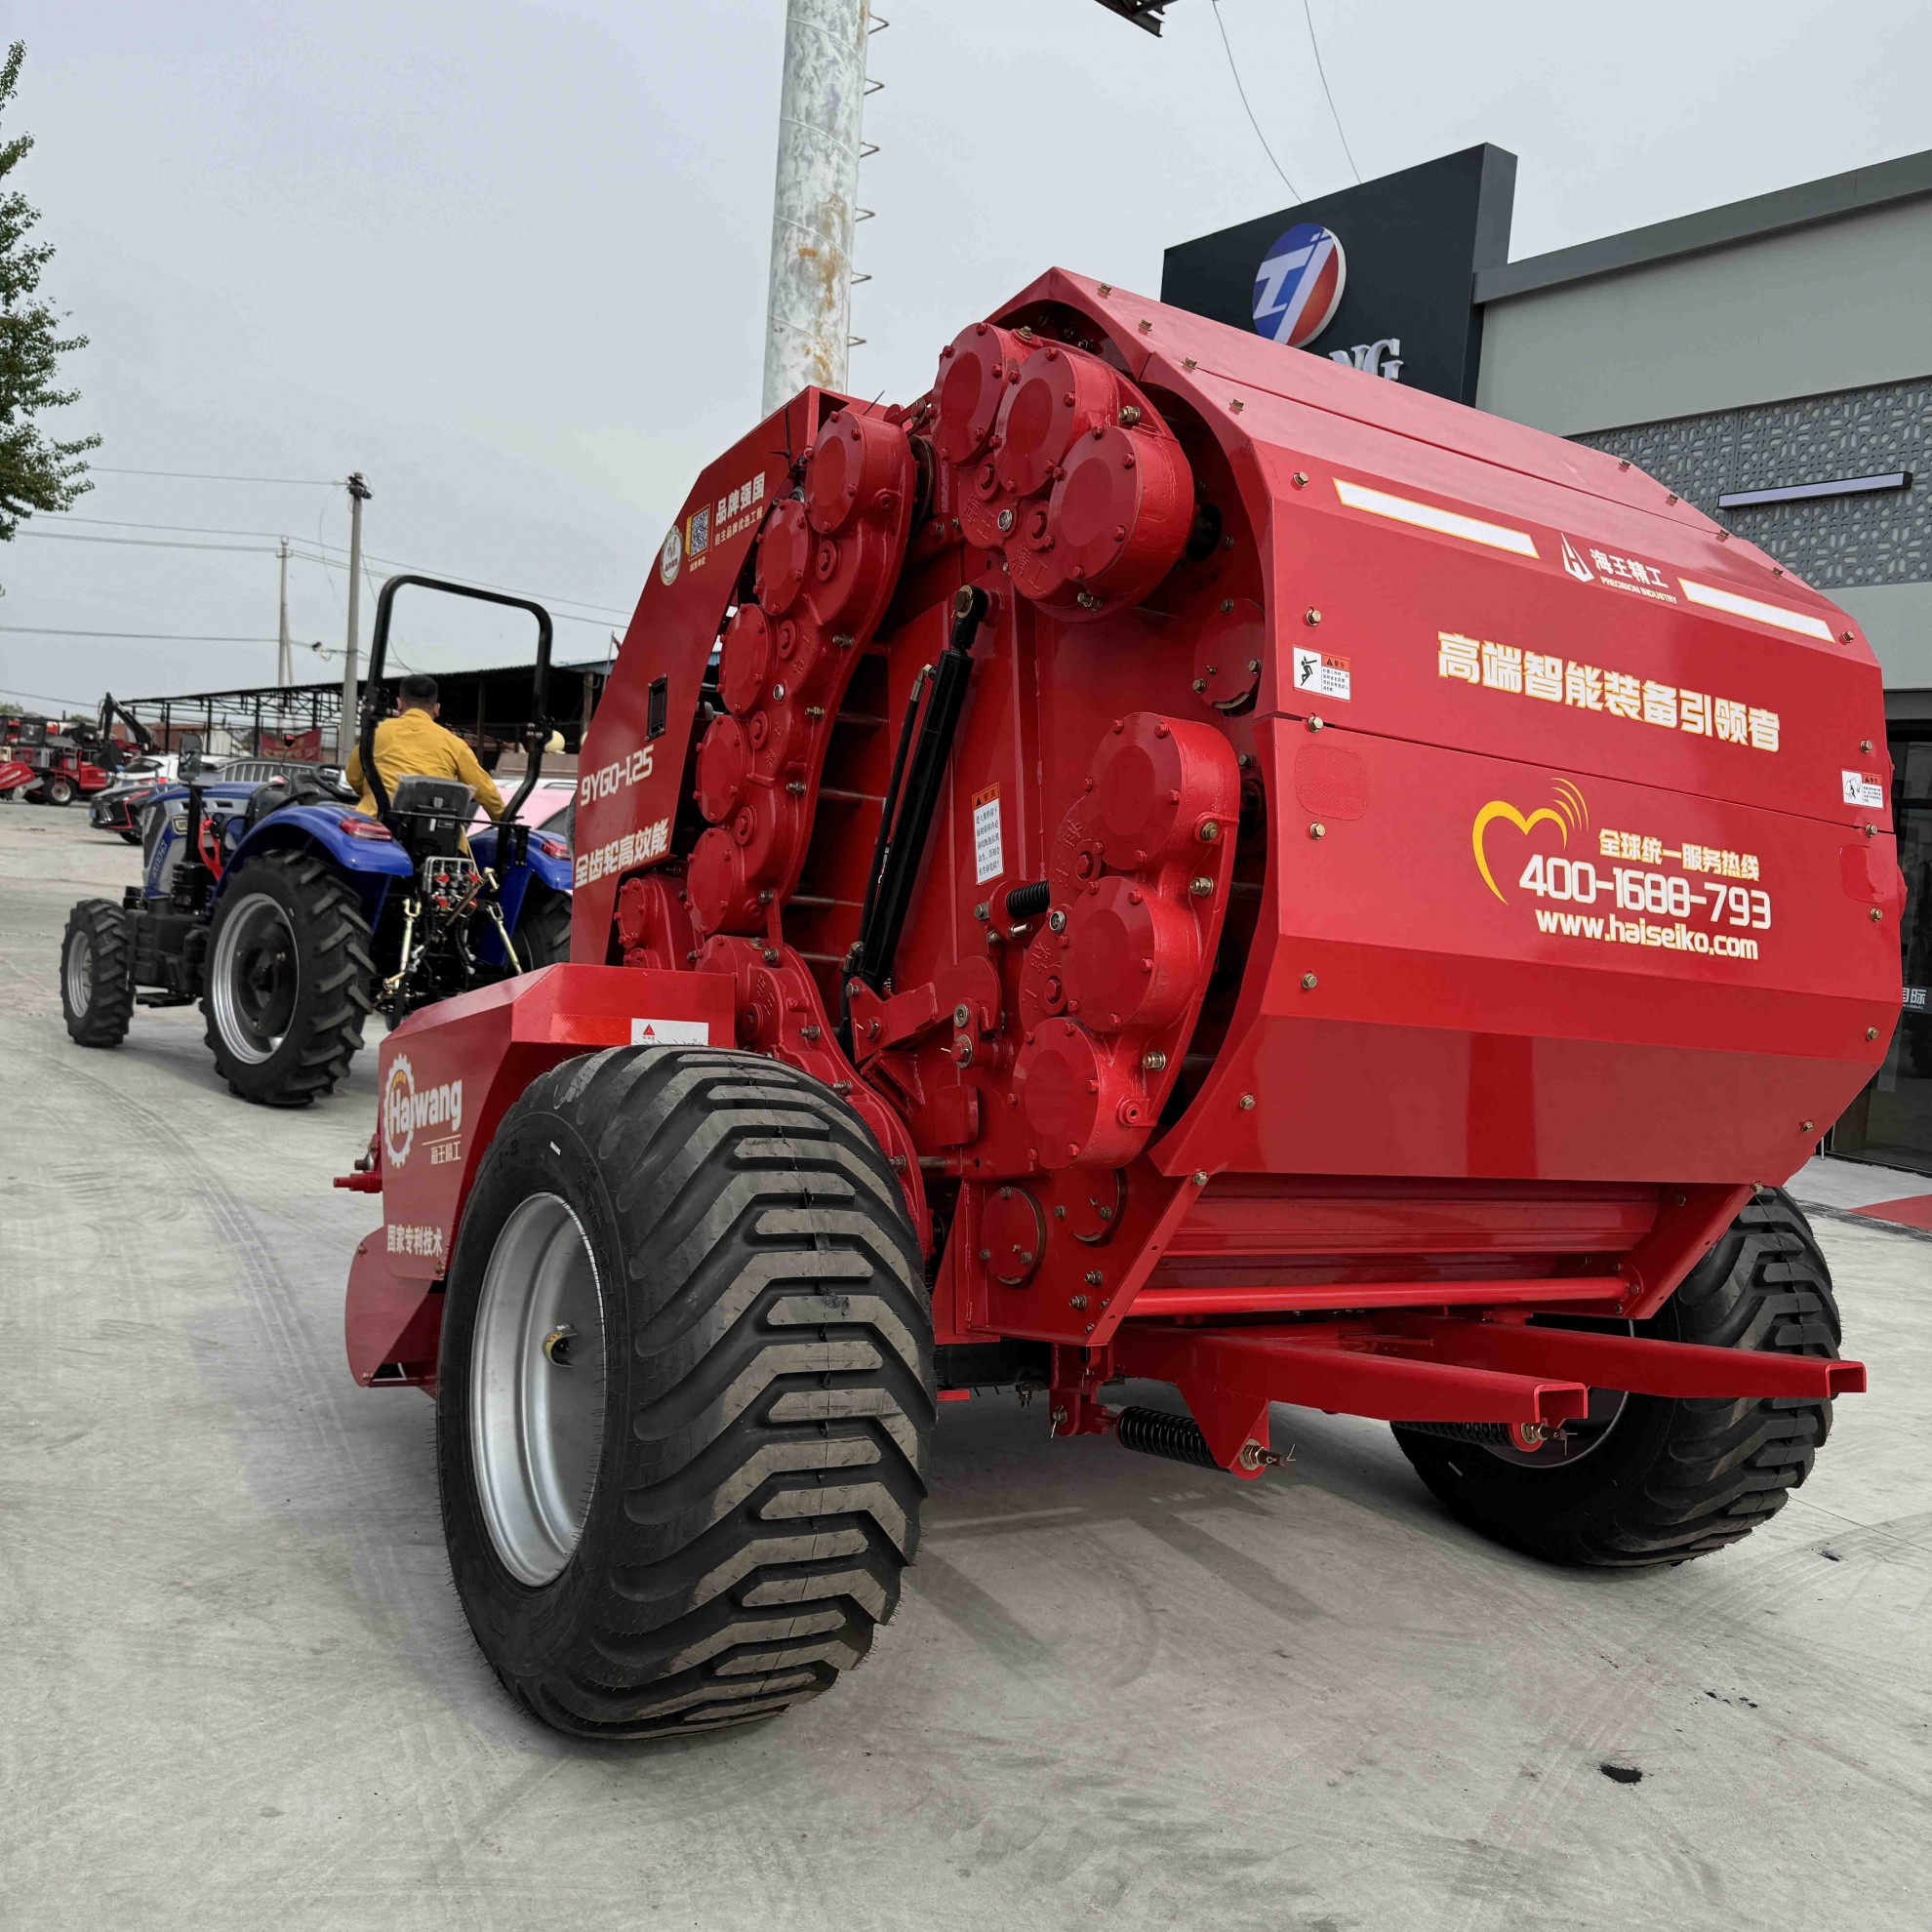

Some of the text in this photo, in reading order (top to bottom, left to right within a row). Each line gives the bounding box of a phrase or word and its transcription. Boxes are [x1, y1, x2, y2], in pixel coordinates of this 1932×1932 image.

[715, 471, 766, 527] 品牌强国
[1589, 547, 1670, 588] 海王精工
[1437, 630, 1781, 752] 高端智能装备引领者
[575, 817, 670, 889] 全齿轮高效能
[1598, 827, 1760, 881] 全球统一服务热线
[1519, 854, 1771, 930] 400-1688-793
[1535, 908, 1758, 960] www.haiseiko.com
[389, 1079, 463, 1133] Haiwang
[386, 1224, 442, 1257] 国家专利技术
